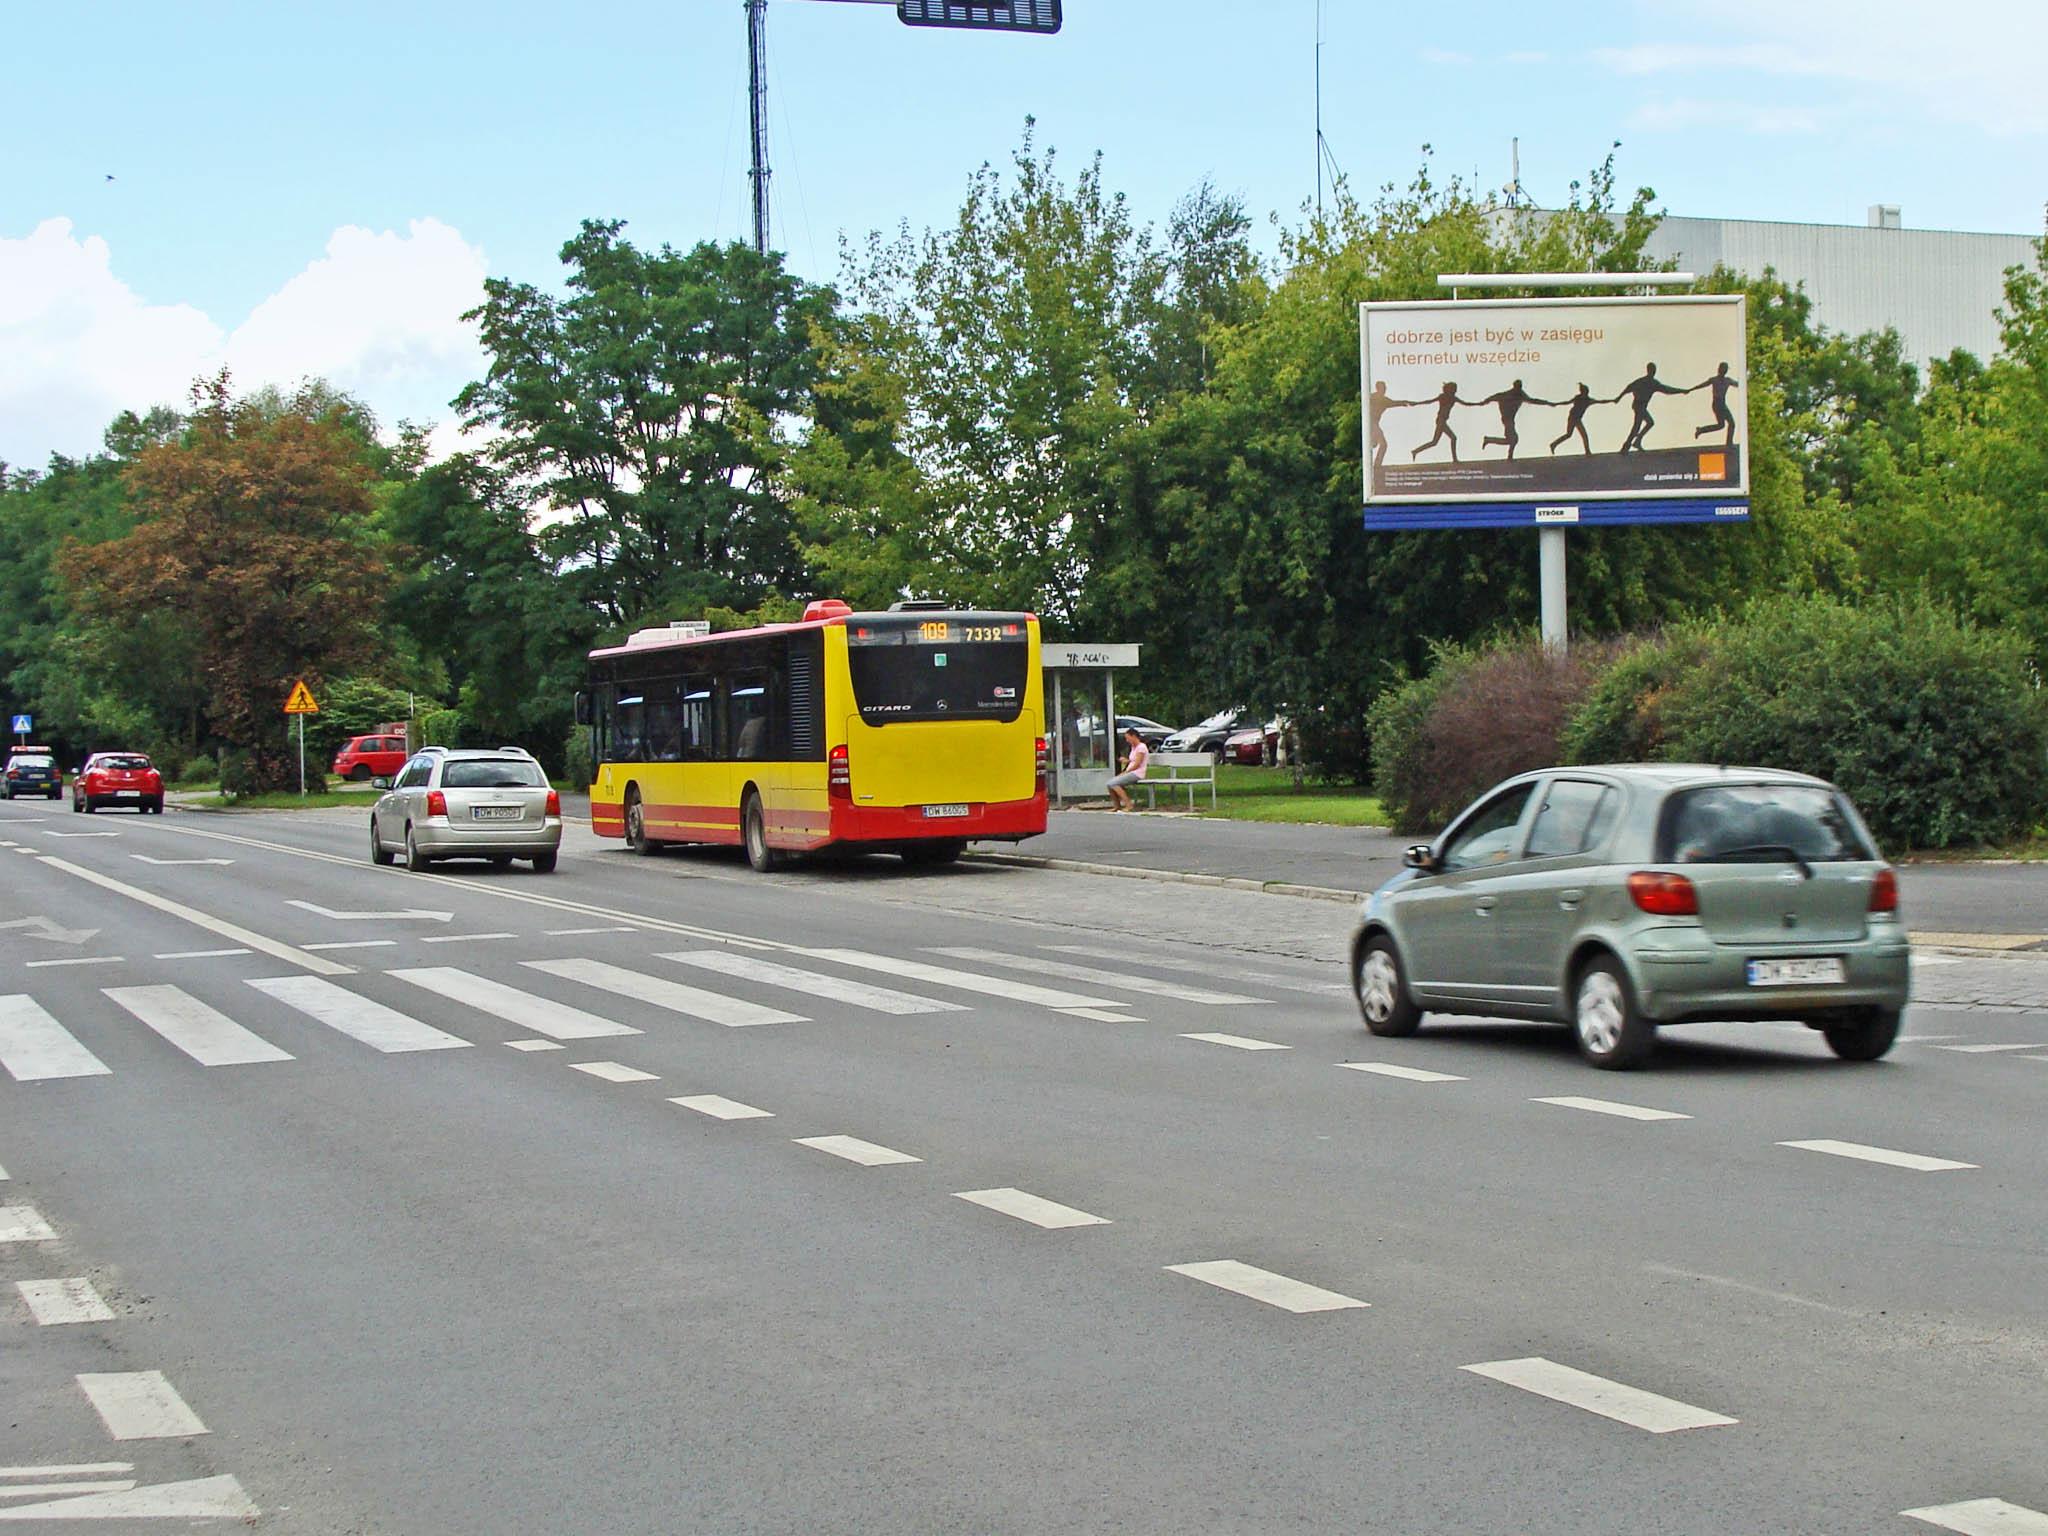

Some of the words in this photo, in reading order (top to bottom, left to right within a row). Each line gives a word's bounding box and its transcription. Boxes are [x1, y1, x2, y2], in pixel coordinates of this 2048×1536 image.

[1386, 329, 1443, 344] dobrze
[1449, 328, 1478, 346] jest
[1485, 328, 1514, 345] być
[1521, 331, 1534, 342] w
[1540, 326, 1604, 344] zasięgu
[1387, 351, 1459, 366] internetu
[1466, 348, 1541, 367] wszędzie
[920, 622, 947, 641] 109
[965, 627, 1002, 641] 7332
[863, 704, 911, 712] CITARO
